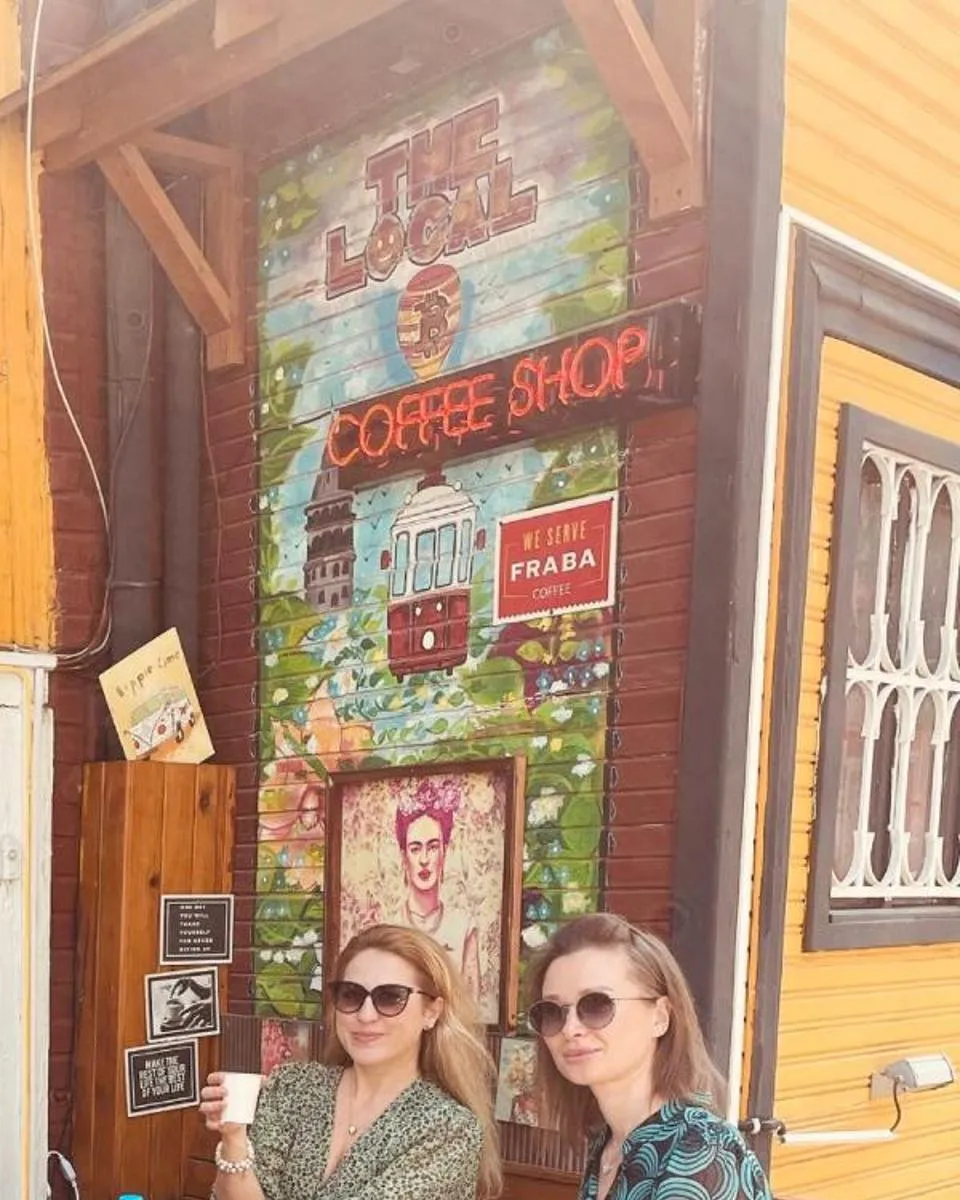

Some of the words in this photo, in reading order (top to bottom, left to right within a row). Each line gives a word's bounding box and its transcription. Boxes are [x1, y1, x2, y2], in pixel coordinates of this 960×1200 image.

[366, 98, 500, 216] THE
[326, 156, 538, 300] LOCAL
[326, 374, 495, 466] COFFEE
[508, 326, 647, 420] SHOP
[510, 548, 596, 582] FRABA
[523, 530, 541, 551] WE
[547, 520, 588, 546] SERVE
[532, 582, 572, 599] COFFEE
